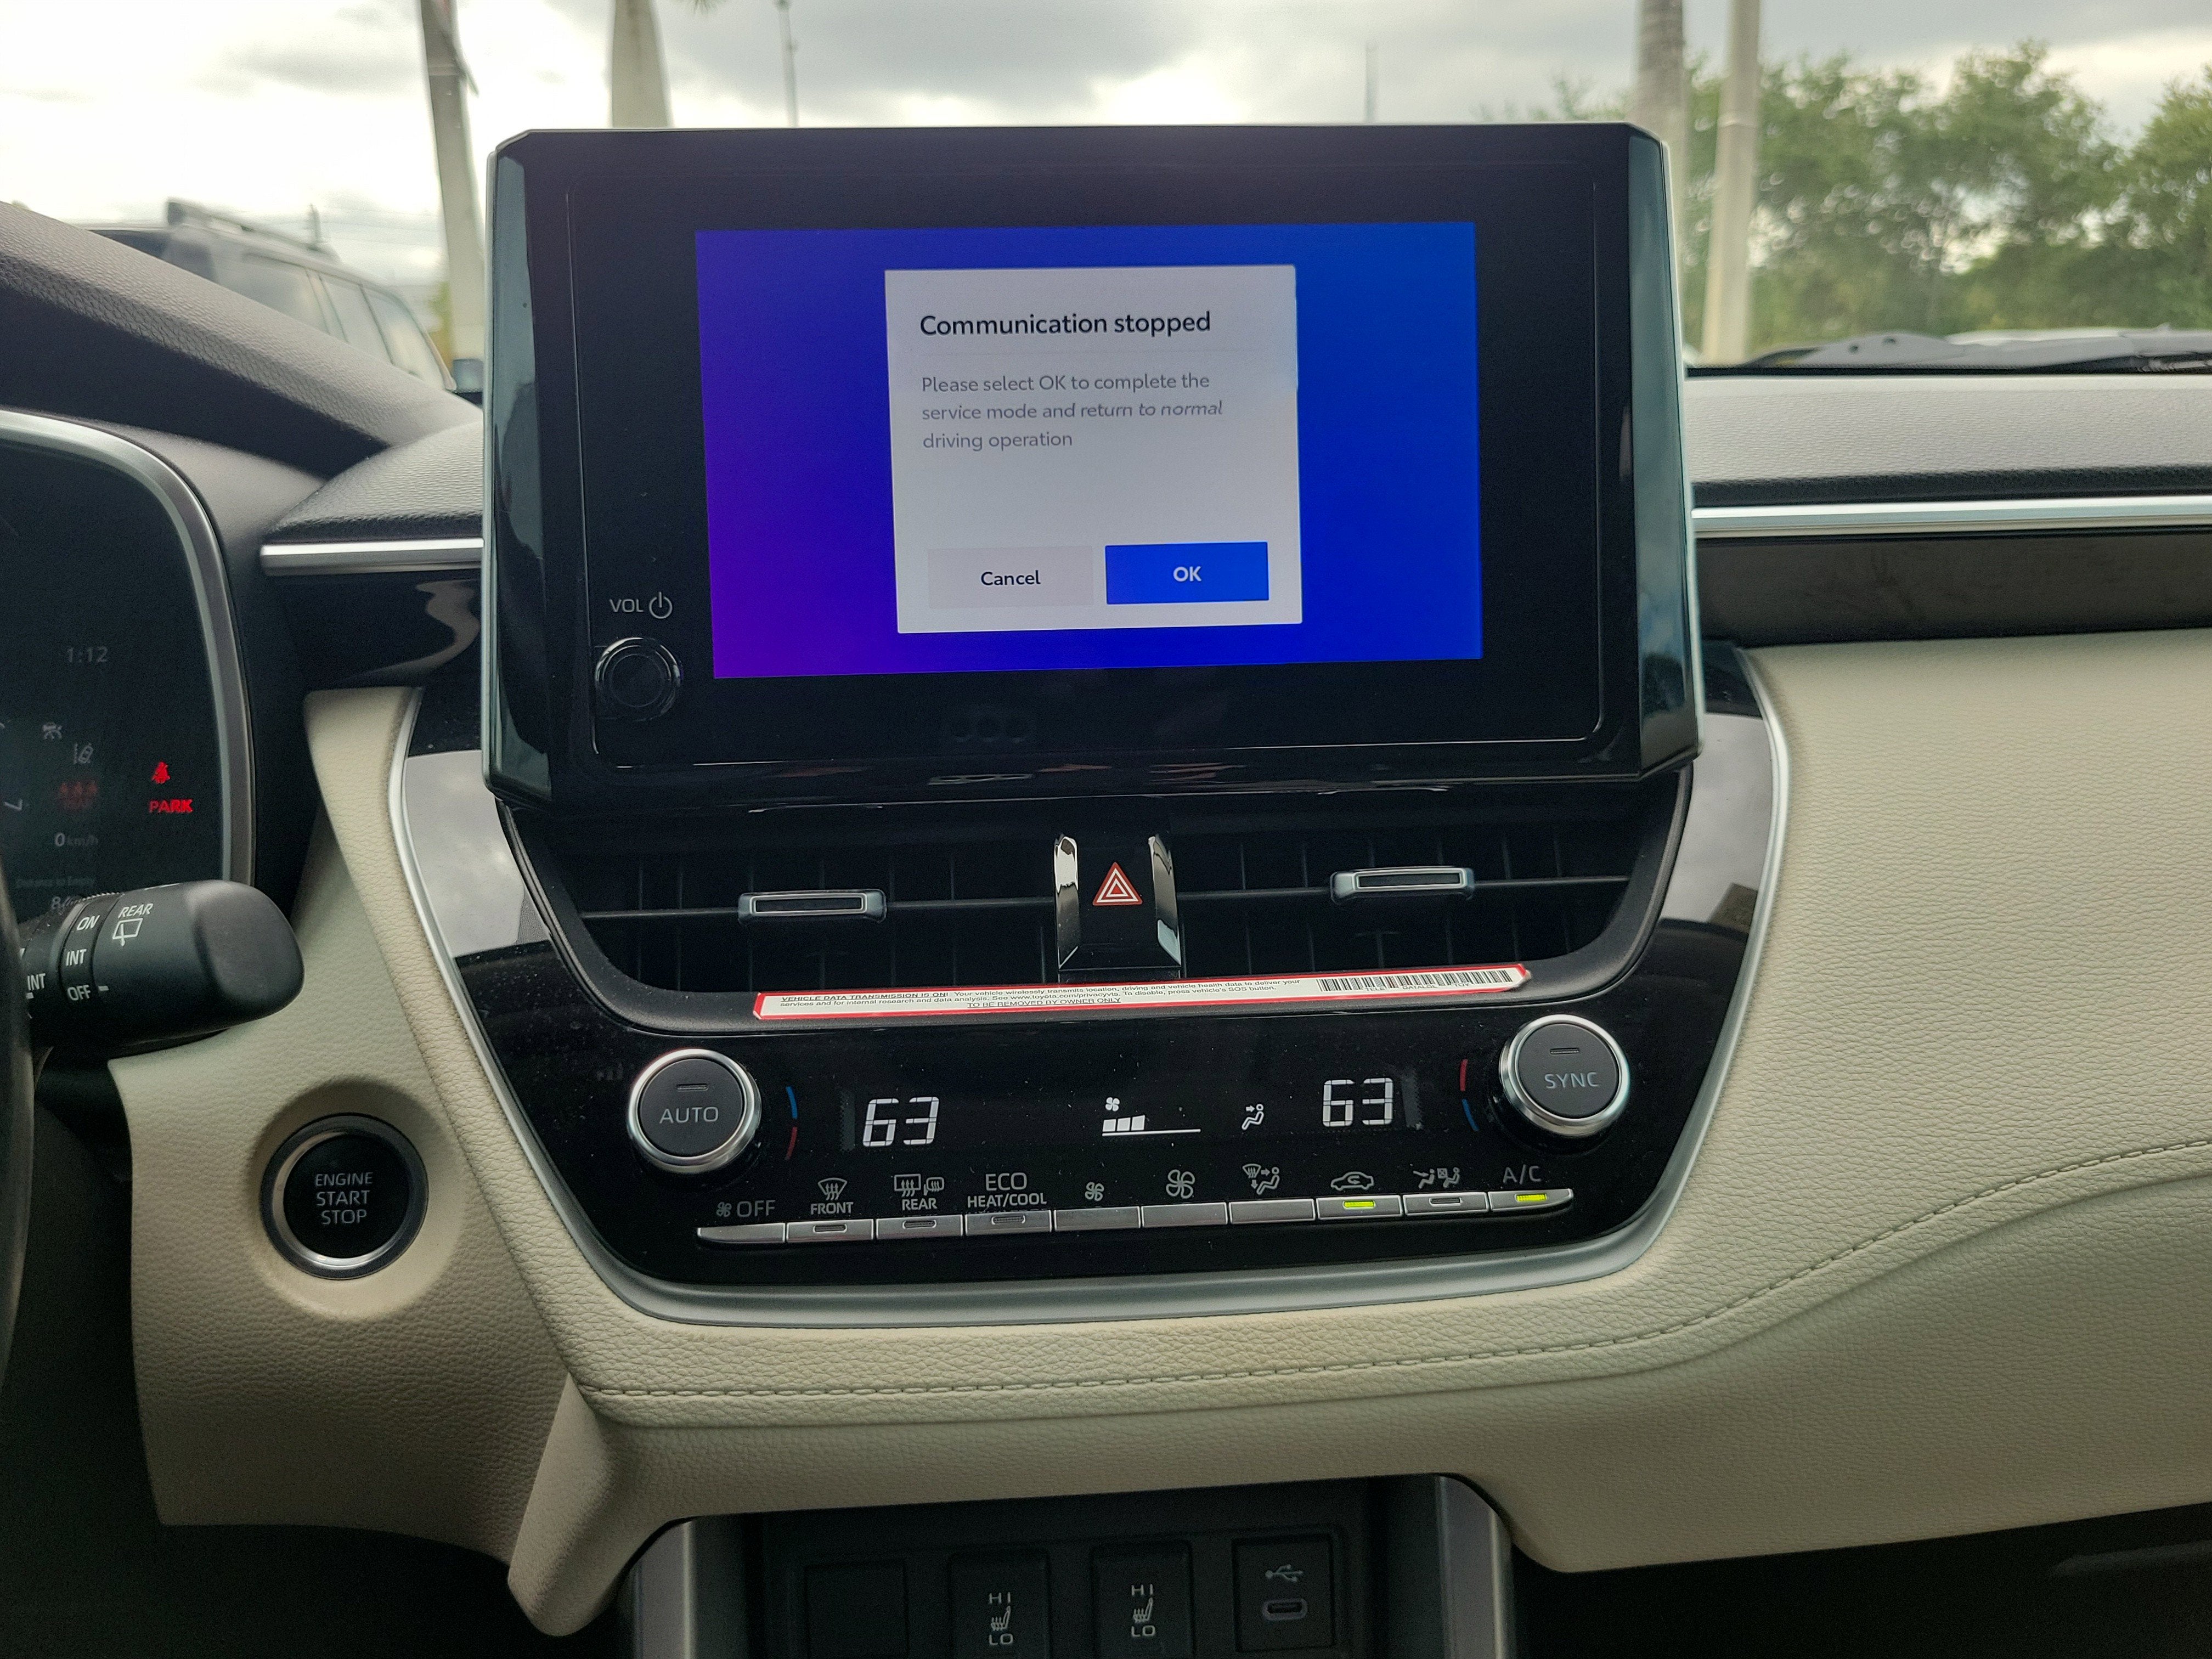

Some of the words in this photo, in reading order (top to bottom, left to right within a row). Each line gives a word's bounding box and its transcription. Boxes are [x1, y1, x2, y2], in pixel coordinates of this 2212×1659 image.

[920, 313, 1107, 336] Communication
[1114, 311, 1211, 337] stopped
[922, 377, 979, 393] Please
[983, 376, 1034, 392] select
[1039, 375, 1066, 391] OK
[1071, 375, 1090, 390] to
[1094, 374, 1177, 393] complete
[1182, 373, 1210, 388] the
[922, 404, 981, 420] service
[988, 403, 1037, 419] mode
[1042, 403, 1076, 419] and
[1081, 403, 1133, 418] return
[1139, 402, 1155, 417] to
[1161, 400, 1223, 416] normal
[923, 432, 983, 452] driving
[989, 431, 1073, 451] operation
[980, 570, 1041, 586] Cancel
[1173, 566, 1202, 582] OK
[610, 599, 644, 612] VOL
[67, 646, 108, 663] 1:12
[149, 798, 193, 814] PARK
[54, 832, 65, 847] 0
[118, 902, 154, 917] REAR
[76, 915, 100, 931] ON
[65, 949, 87, 966] INT
[27, 973, 46, 991] INT
[67, 984, 91, 1001] OFF
[1544, 1071, 1599, 1089] SYNC
[1322, 1077, 1393, 1127] 63
[659, 1106, 720, 1125] AUTO
[862, 1096, 940, 1148] 63
[314, 1172, 374, 1187] ENGINE
[985, 1172, 1028, 1191] ECO
[1503, 1165, 1542, 1184] A/C
[316, 1190, 370, 1206] START
[901, 1197, 938, 1211] REAR
[967, 1192, 1047, 1208] HEAT/COOL
[736, 1200, 776, 1217] OFF
[810, 1201, 854, 1215] FRONT
[320, 1209, 367, 1225] STOP
[989, 1592, 1012, 1604] HI
[1131, 1584, 1153, 1596] HI
[989, 1633, 1014, 1646] LO
[1131, 1625, 1156, 1638] LO
